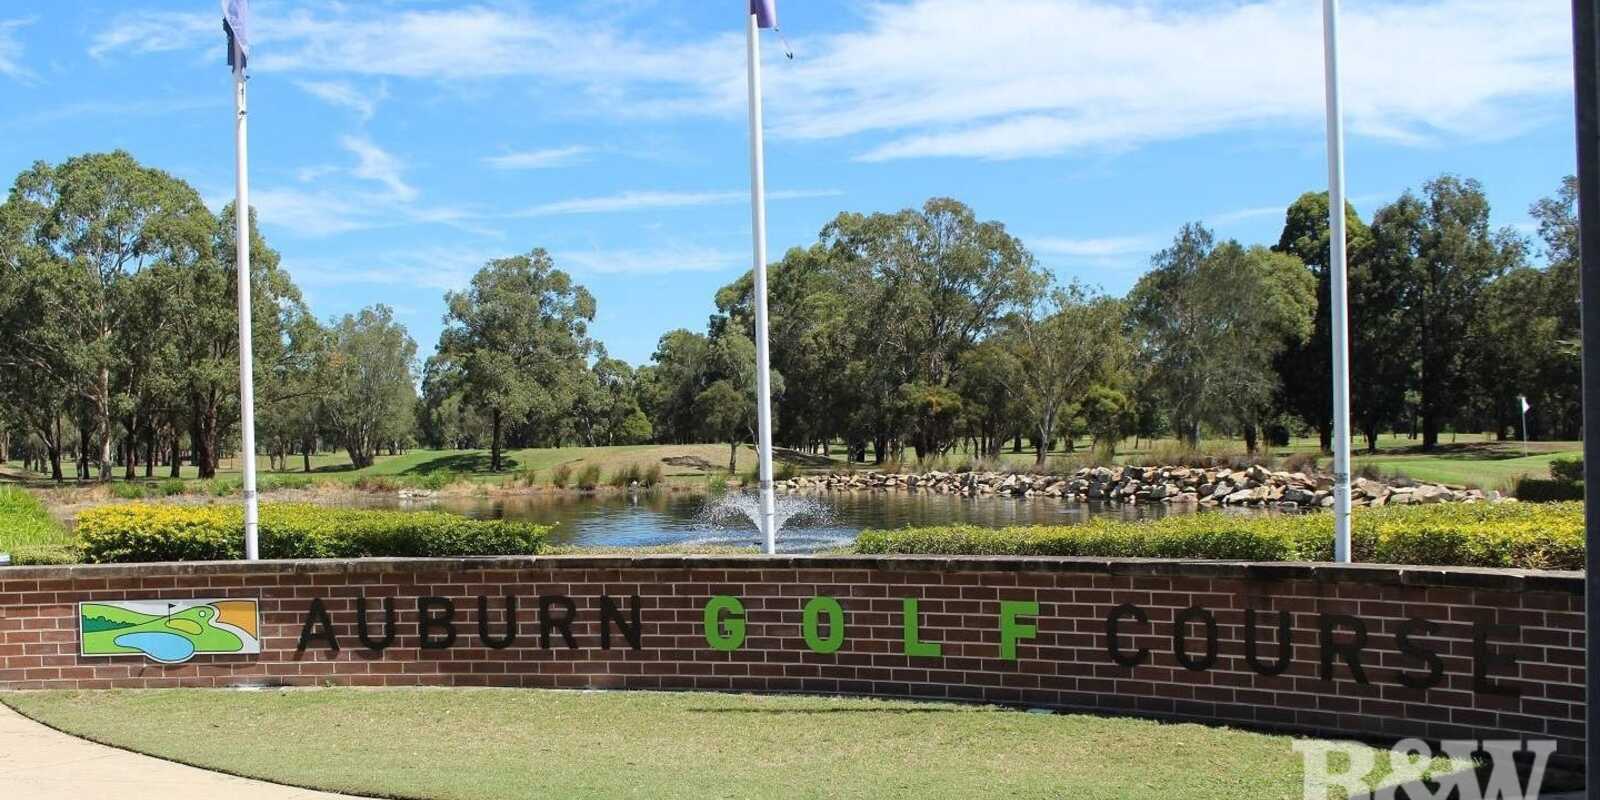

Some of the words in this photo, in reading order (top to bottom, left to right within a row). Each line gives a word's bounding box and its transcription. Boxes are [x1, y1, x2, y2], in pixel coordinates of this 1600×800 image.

[296, 594, 643, 652] AUBURN
[704, 595, 1039, 660] GOLF
[1106, 603, 1521, 697] COURSE
